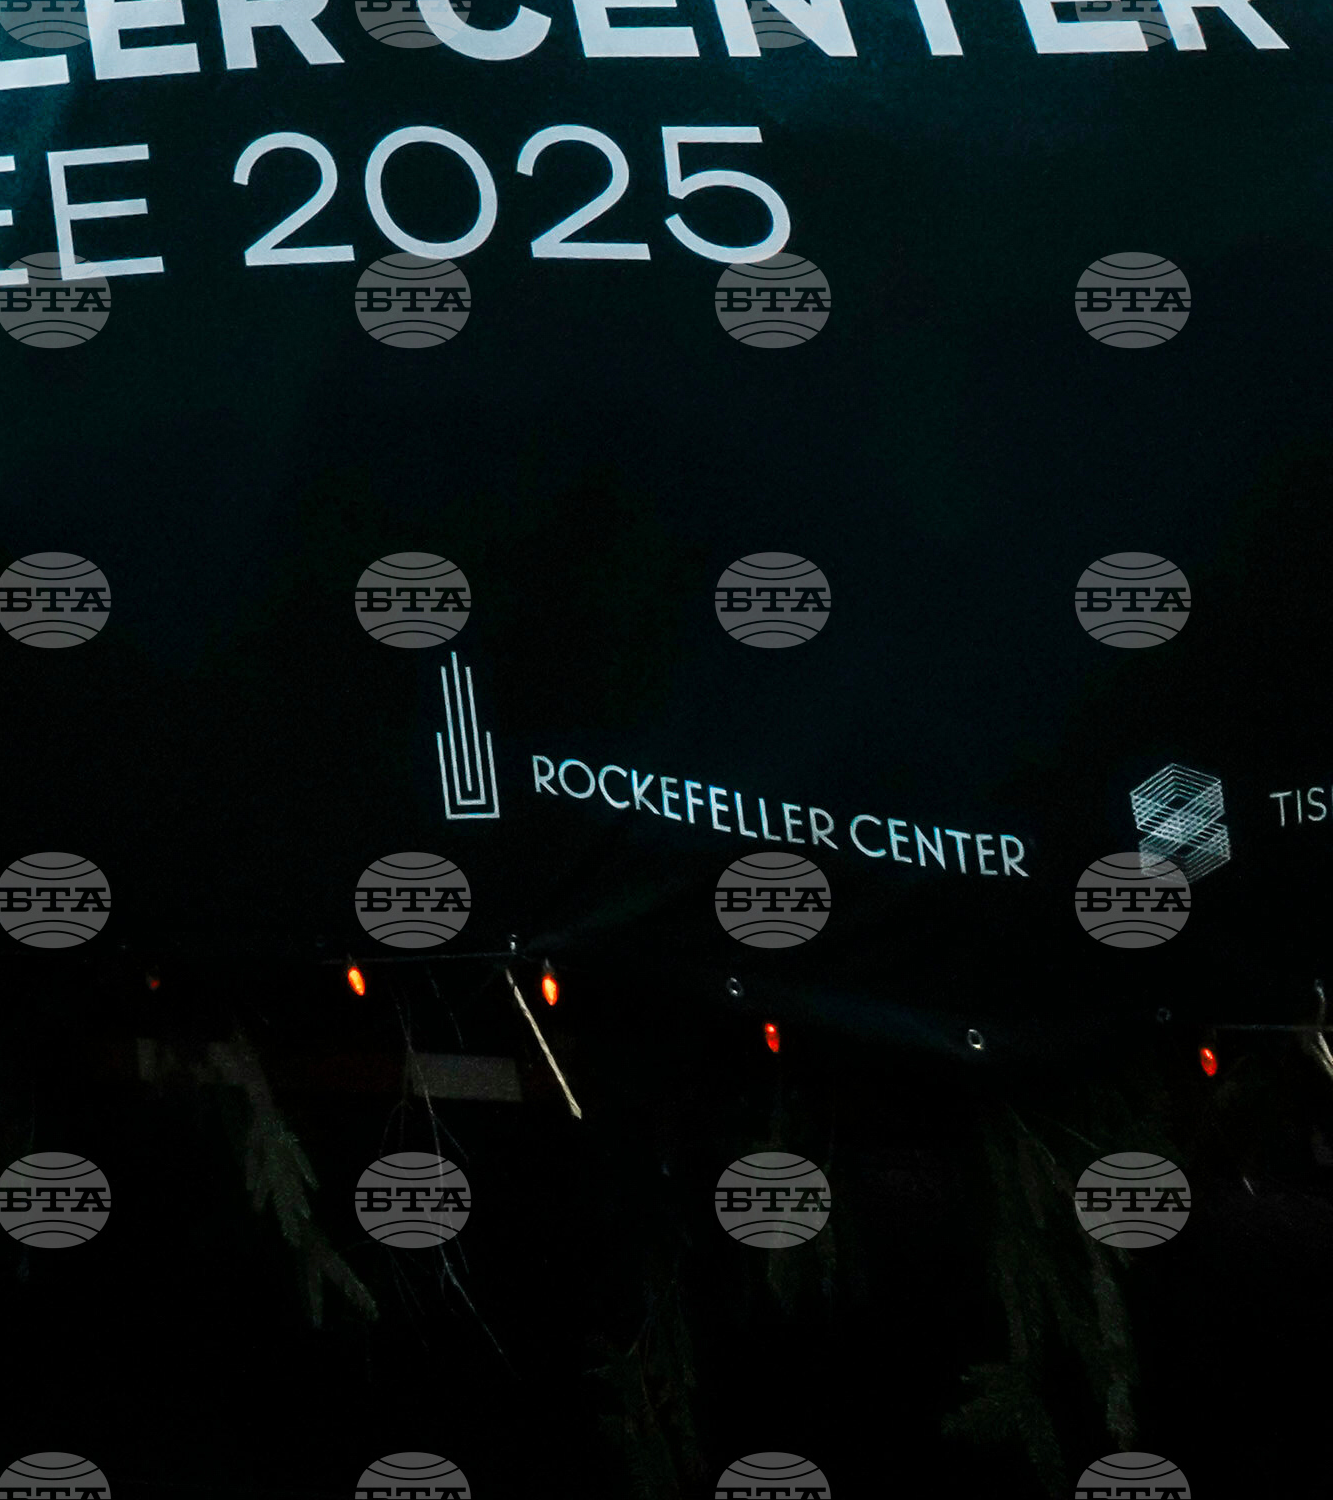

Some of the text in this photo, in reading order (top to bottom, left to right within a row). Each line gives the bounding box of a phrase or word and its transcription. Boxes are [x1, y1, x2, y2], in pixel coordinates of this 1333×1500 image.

[234, 126, 790, 265] 2025
[533, 756, 1333, 876] ROCKEFELLER CENTER TIS
